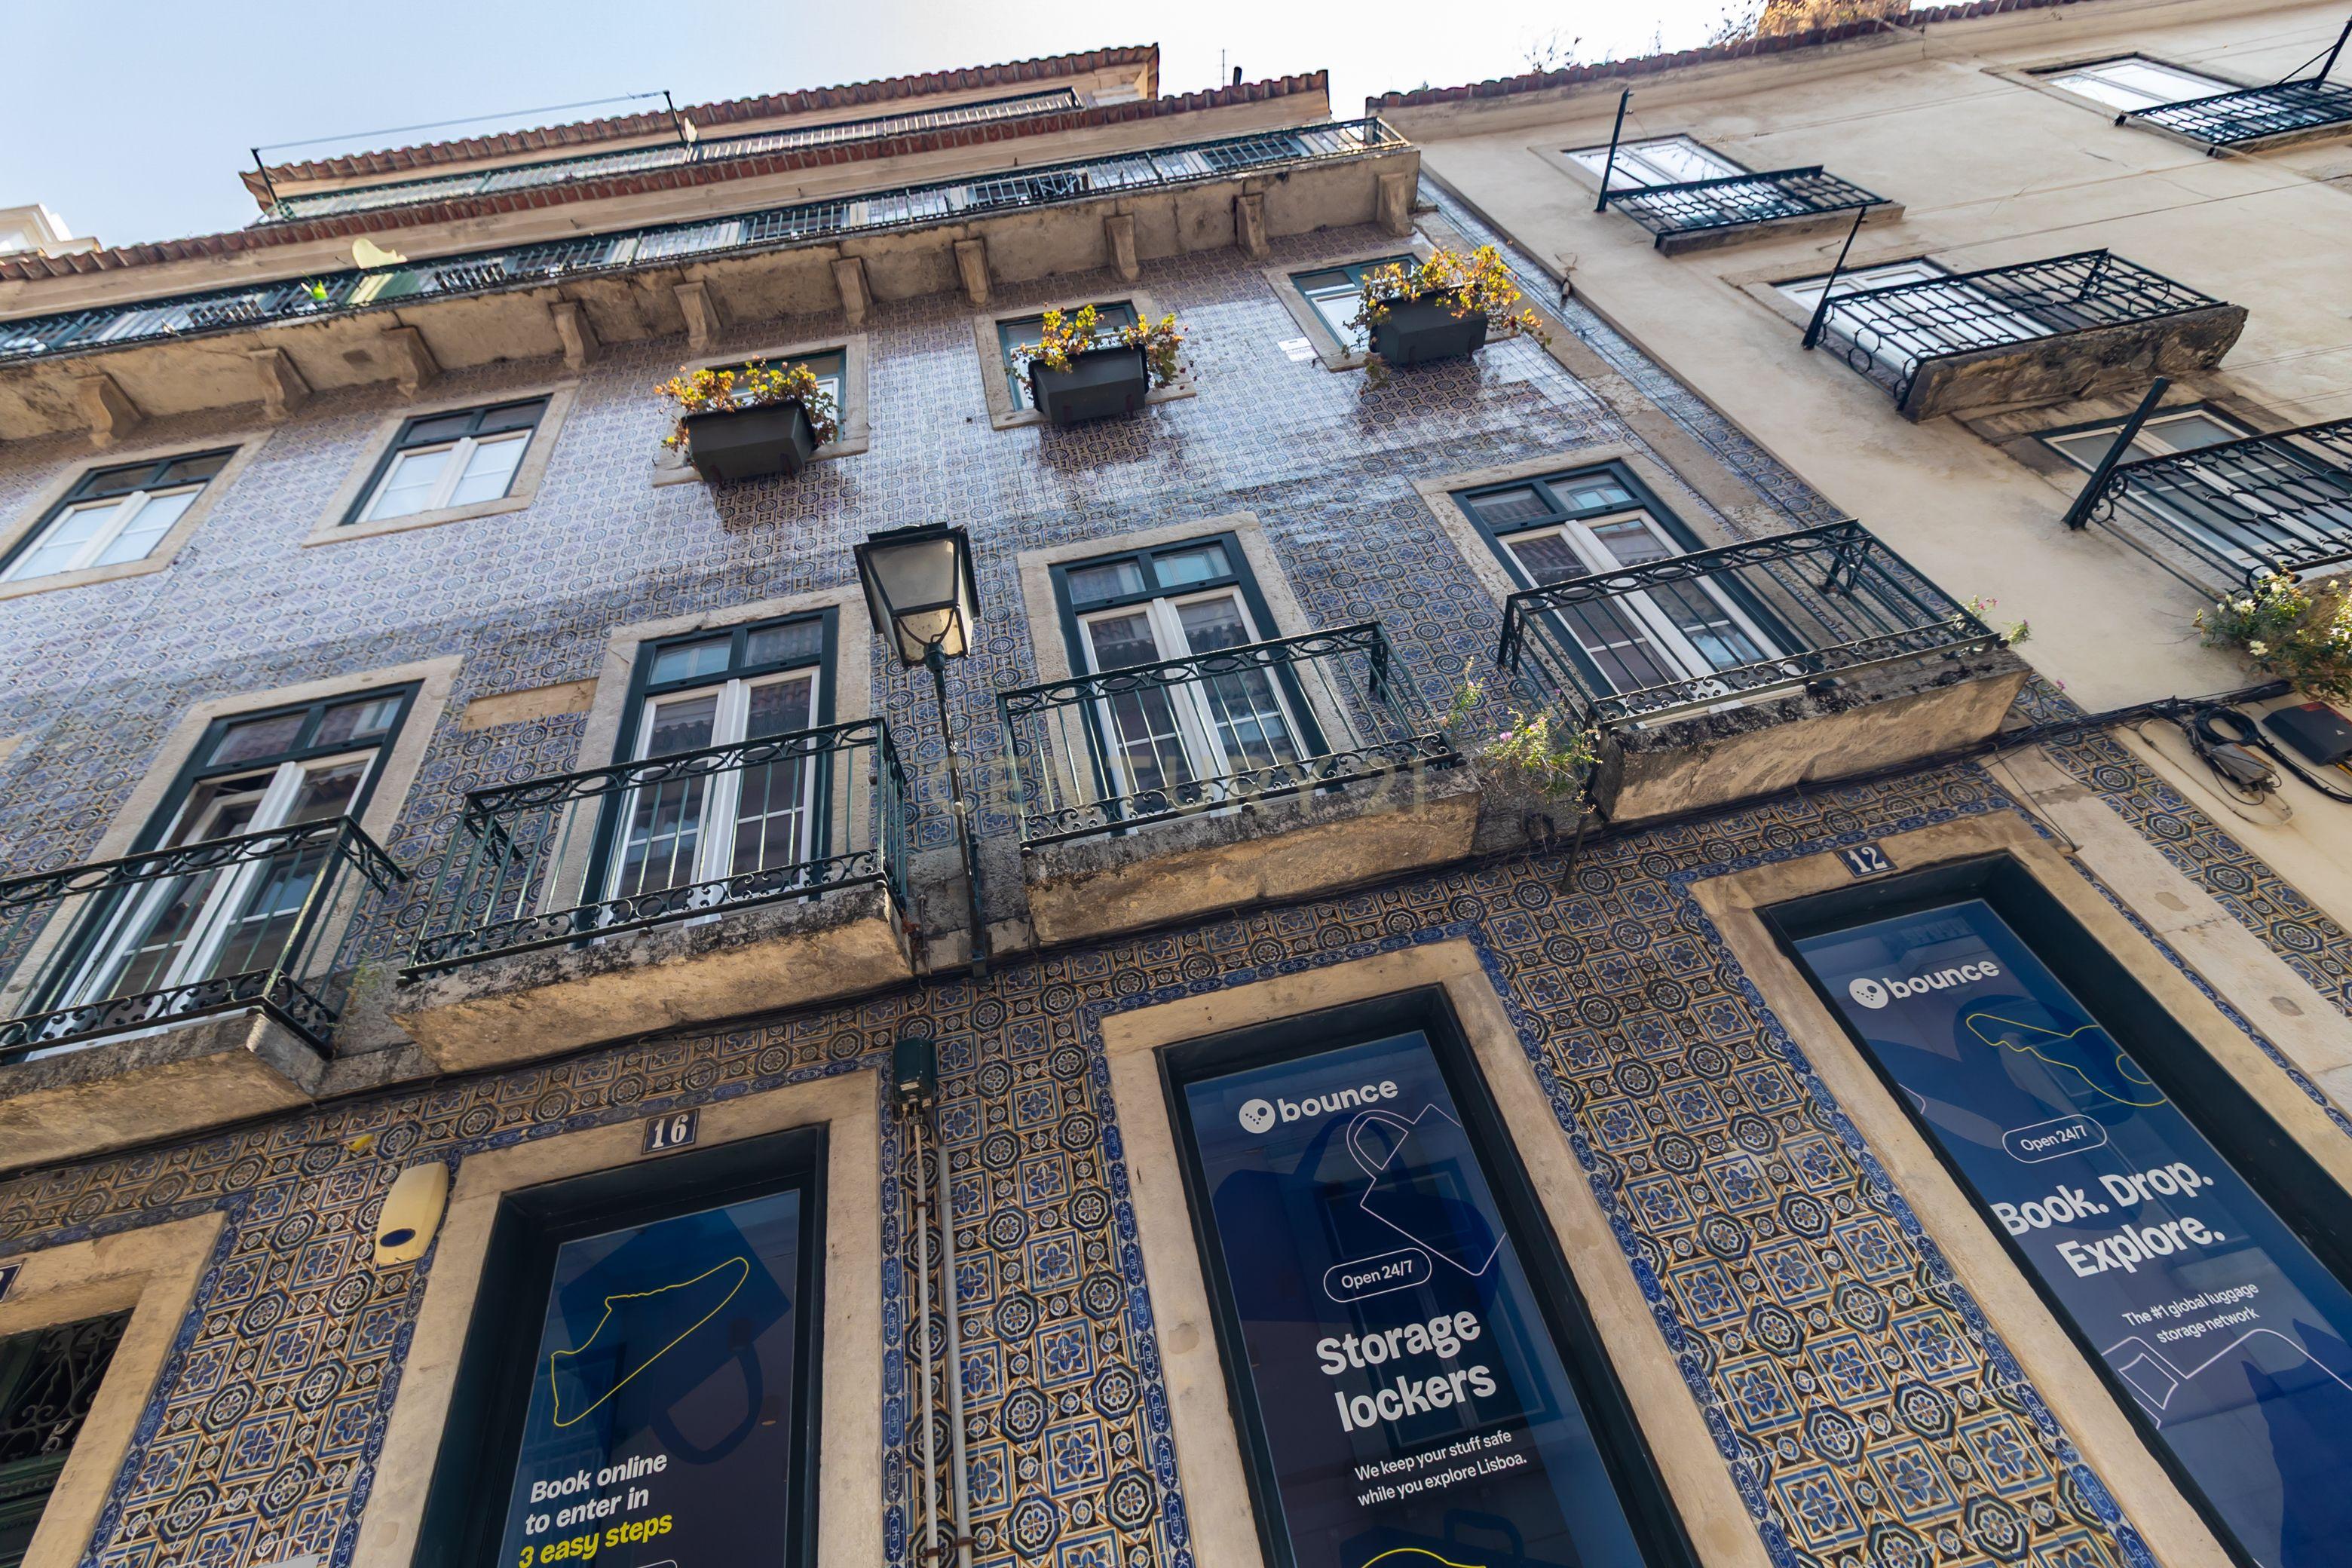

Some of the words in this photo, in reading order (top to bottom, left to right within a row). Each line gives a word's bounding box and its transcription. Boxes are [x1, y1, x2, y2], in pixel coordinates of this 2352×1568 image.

[1847, 846, 1888, 873] 12
[1881, 960, 1999, 999] bounce
[1276, 1080, 1398, 1123] bounce
[652, 1113, 689, 1149] 16
[2020, 1135, 2060, 1152] Open
[2055, 1124, 2087, 1142] 24/7
[1990, 1184, 2110, 1236] Book.
[2098, 1162, 2214, 1208] Drop.
[2055, 1217, 2226, 1278] Explore.
[1341, 1271, 1382, 1290] Open
[1381, 1259, 1412, 1279] 24/7
[2121, 1311, 2153, 1327] The
[2149, 1304, 2170, 1320] #1
[2167, 1294, 2210, 1318] global
[2203, 1283, 2259, 1305] luggage
[2156, 1322, 2207, 1344] storage
[2203, 1306, 2261, 1331] network
[1316, 1311, 1481, 1375] Storage
[1334, 1365, 1496, 1432] lockers
[529, 1469, 592, 1504] Book
[596, 1454, 667, 1487] online
[1354, 1464, 1380, 1481] We
[1380, 1456, 1415, 1475] keep
[1415, 1447, 1447, 1468] your
[1448, 1435, 1481, 1456] stuff
[1482, 1429, 1512, 1448] safe
[1357, 1485, 1395, 1506] while
[1395, 1480, 1423, 1499] you
[1424, 1466, 1477, 1489] explore
[1476, 1453, 1527, 1475] Lisboa.
[525, 1513, 550, 1536] to
[556, 1495, 623, 1528] enter
[626, 1487, 649, 1511] in
[519, 1545, 534, 1568] 3
[540, 1532, 600, 1563] easy
[605, 1514, 672, 1548] steps
